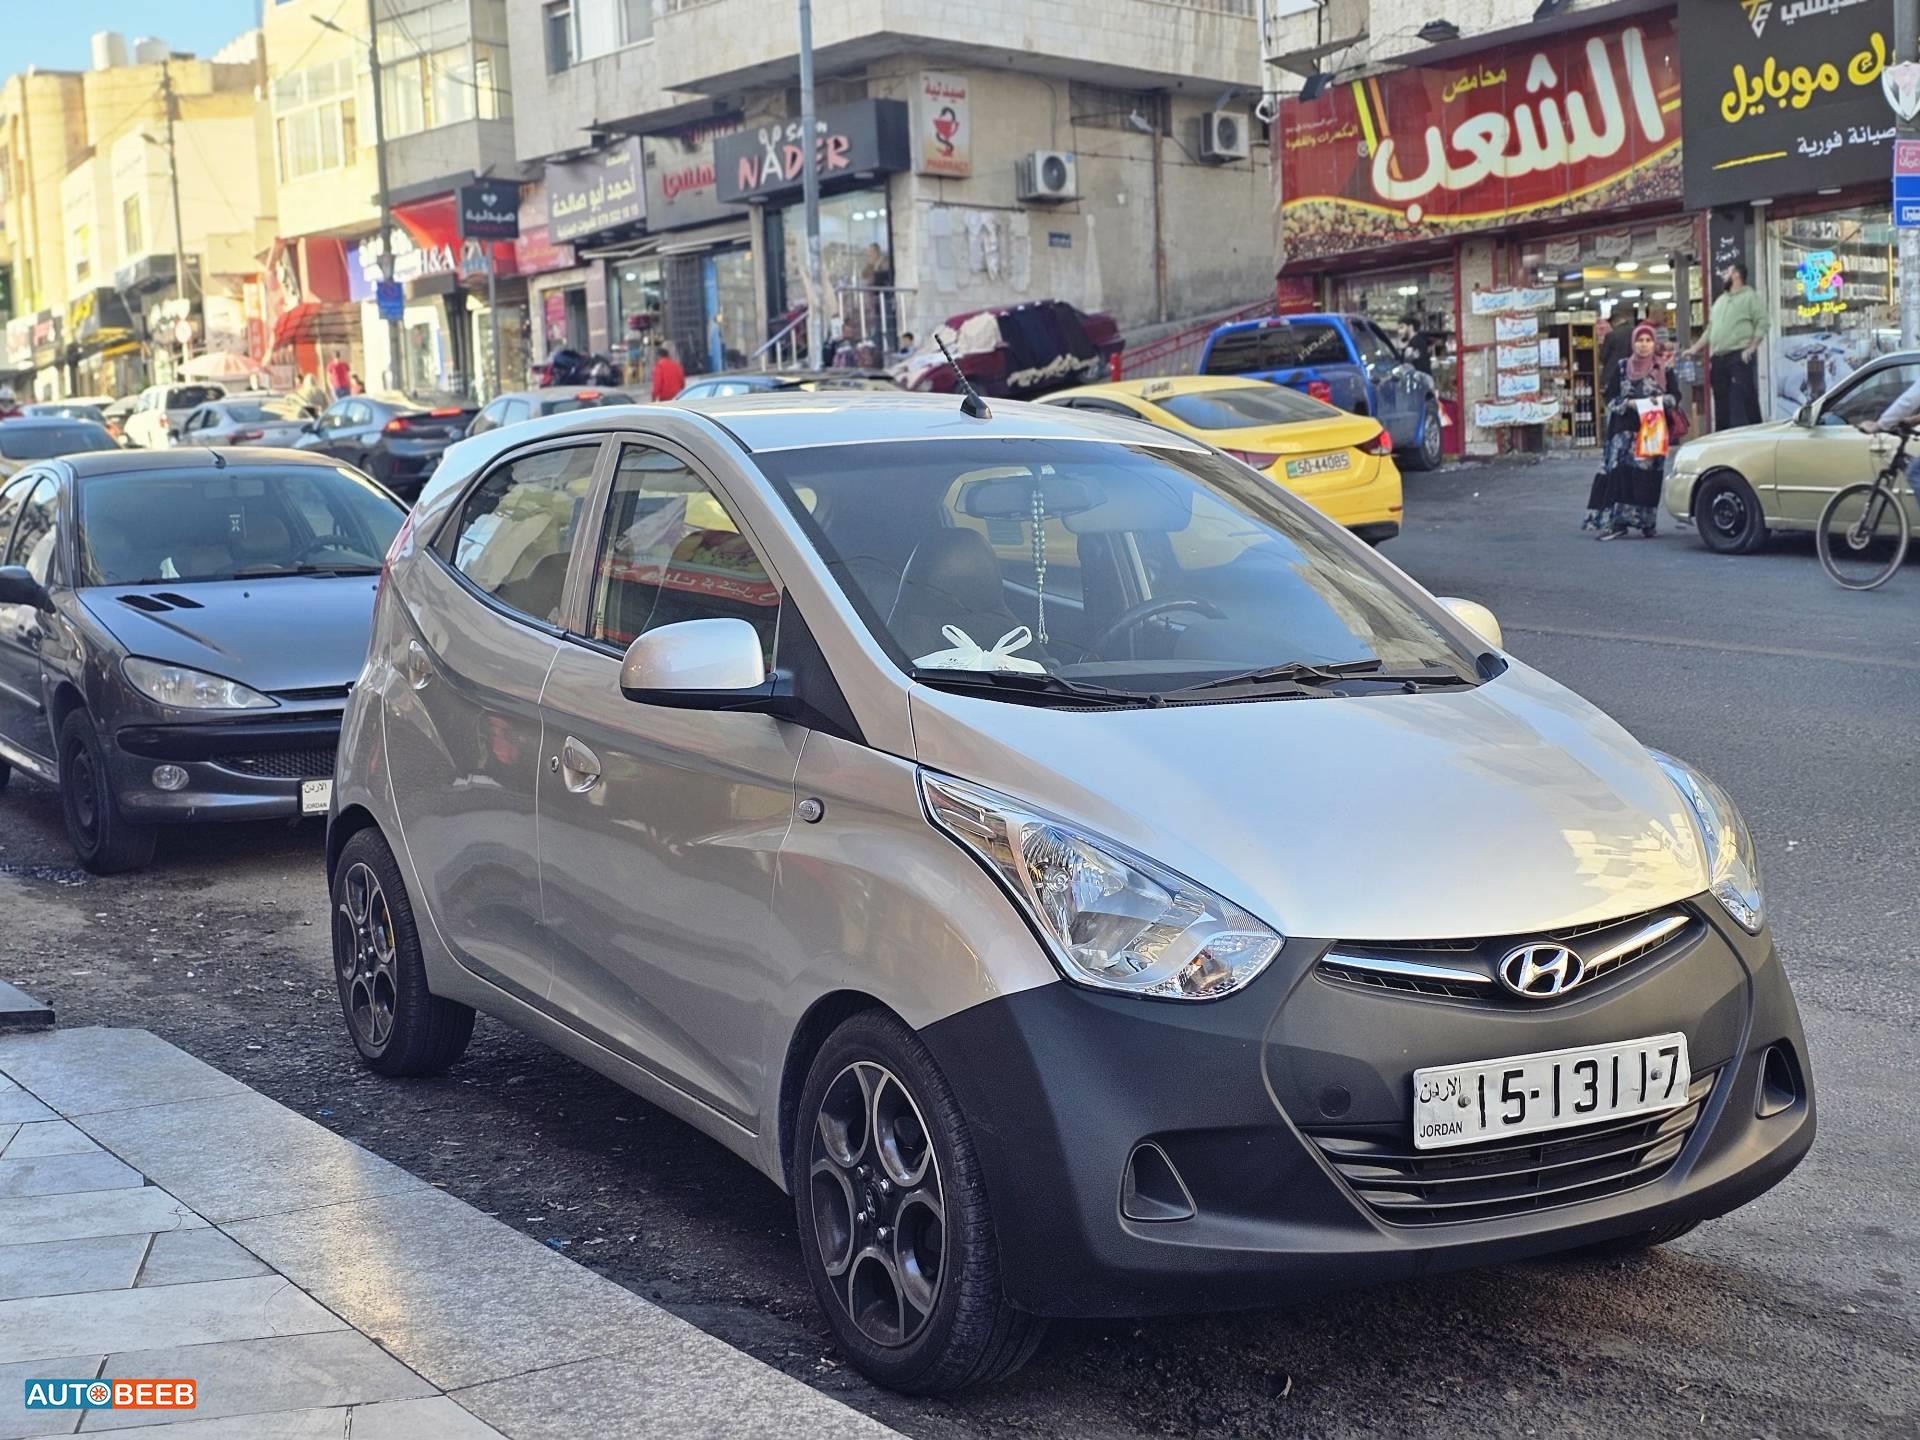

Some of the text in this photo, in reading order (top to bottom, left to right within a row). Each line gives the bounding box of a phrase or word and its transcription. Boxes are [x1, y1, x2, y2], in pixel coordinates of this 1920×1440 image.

[1443, 64, 1507, 102] محامص
[1721, 56, 1840, 123] موبايل
[1372, 27, 1665, 224] الشعب
[1797, 125, 1897, 157] صيانة فورية
[465, 208, 516, 223] صيدلية
[1419, 1075, 1463, 1104] الاردن
[1476, 1045, 1680, 1129] 15-13117
[1419, 1120, 1464, 1138] JORDAN
